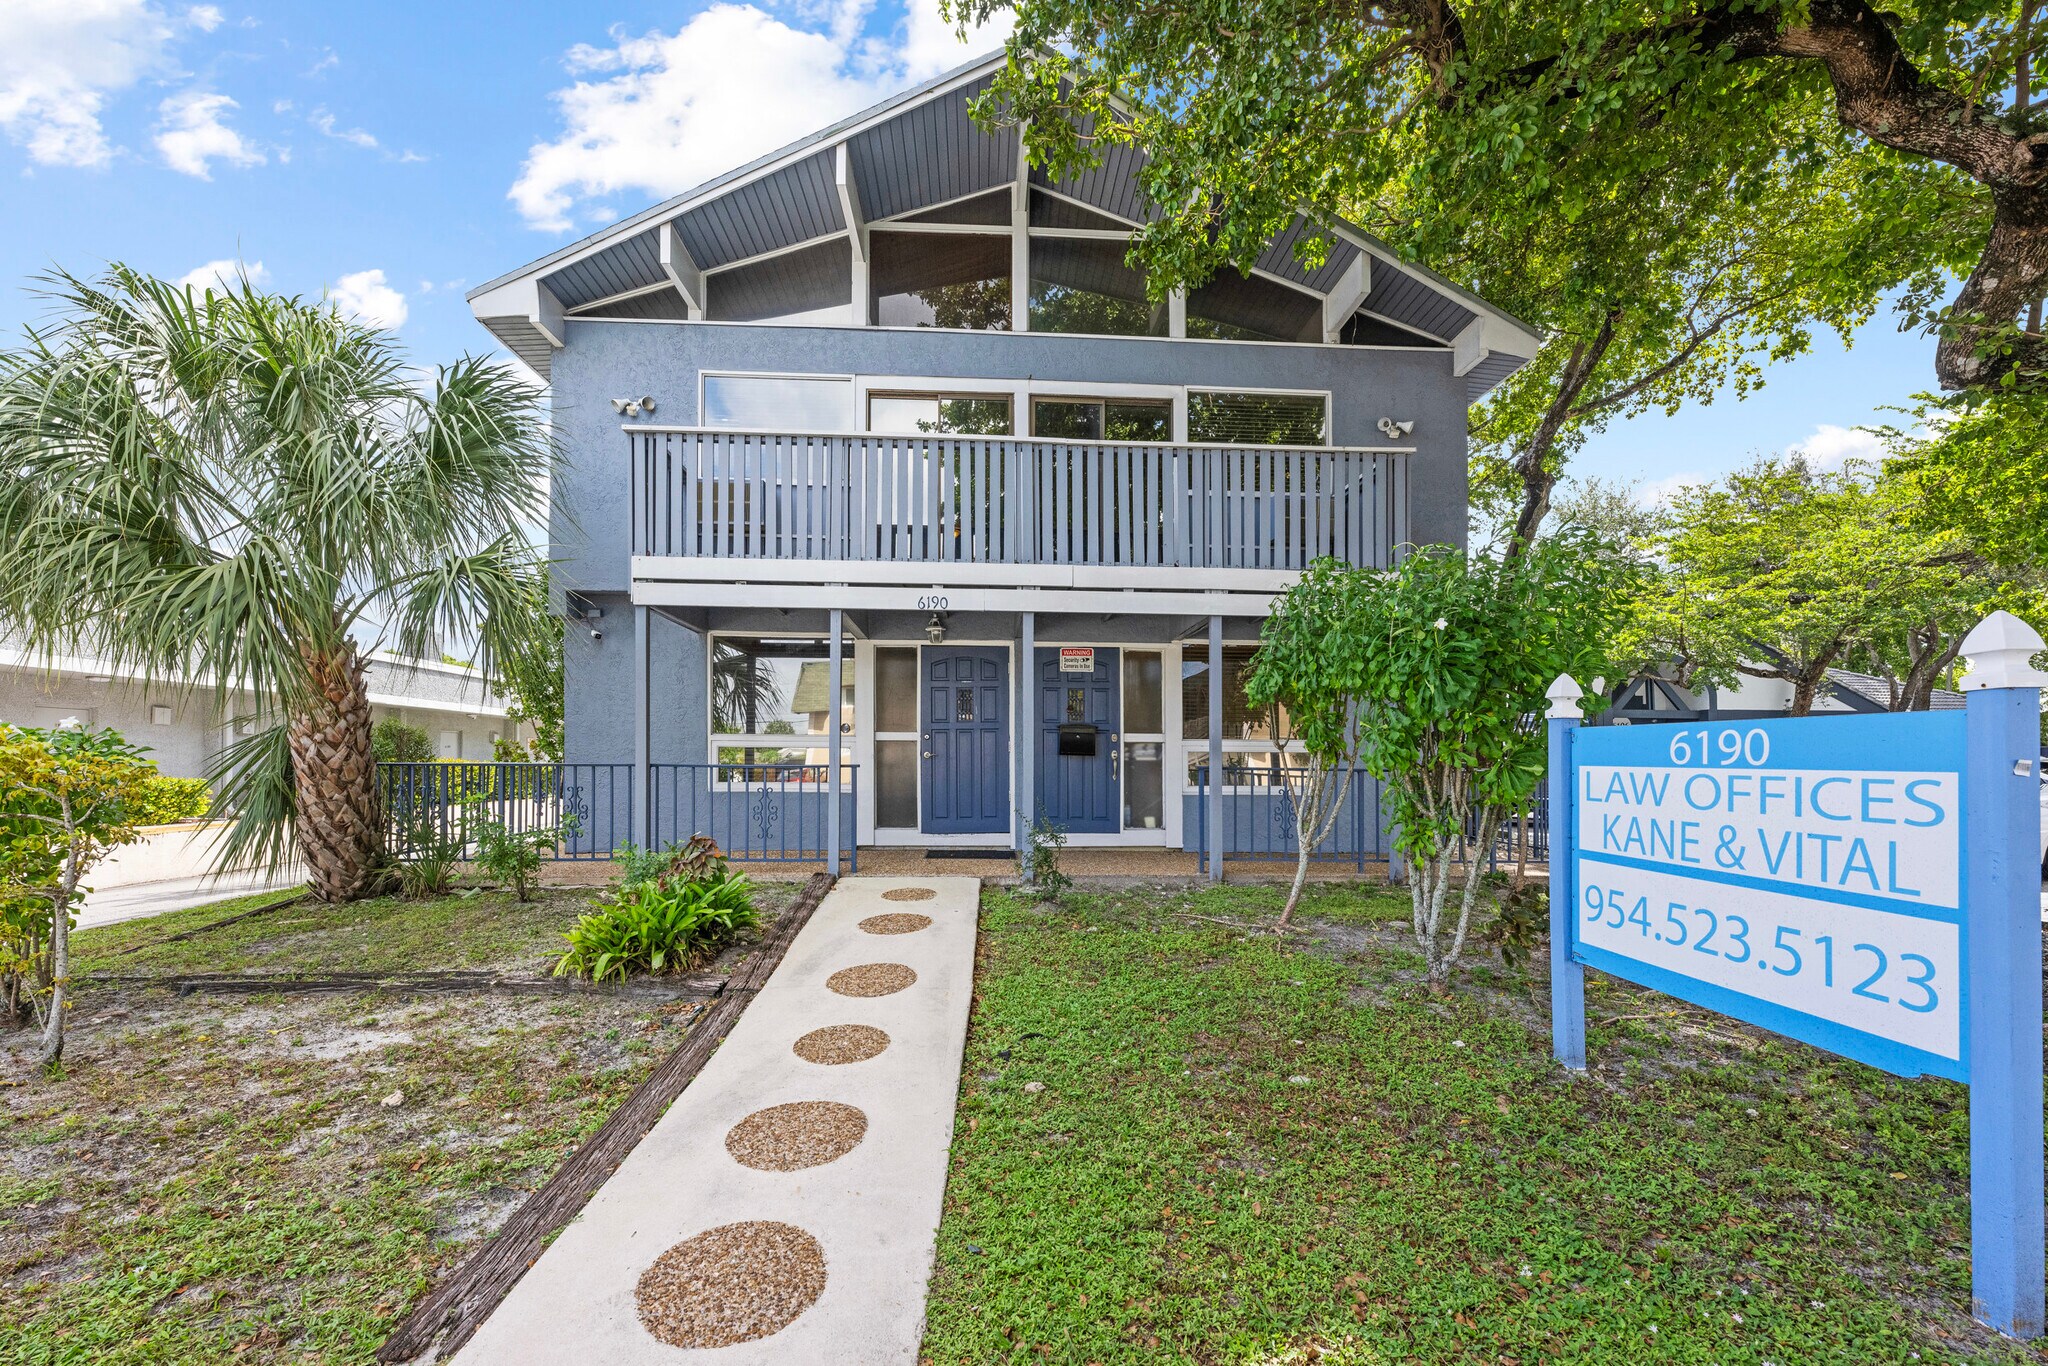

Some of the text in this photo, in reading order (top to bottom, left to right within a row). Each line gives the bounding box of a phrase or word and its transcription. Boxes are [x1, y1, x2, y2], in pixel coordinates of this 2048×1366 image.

[917, 595, 949, 610] 6190
[1669, 728, 1770, 766] 6190
[1586, 770, 1946, 828] LAW OFFICES
[1603, 813, 1921, 897] KANE & VITAL
[1584, 884, 1939, 1014] 954.523.5123
